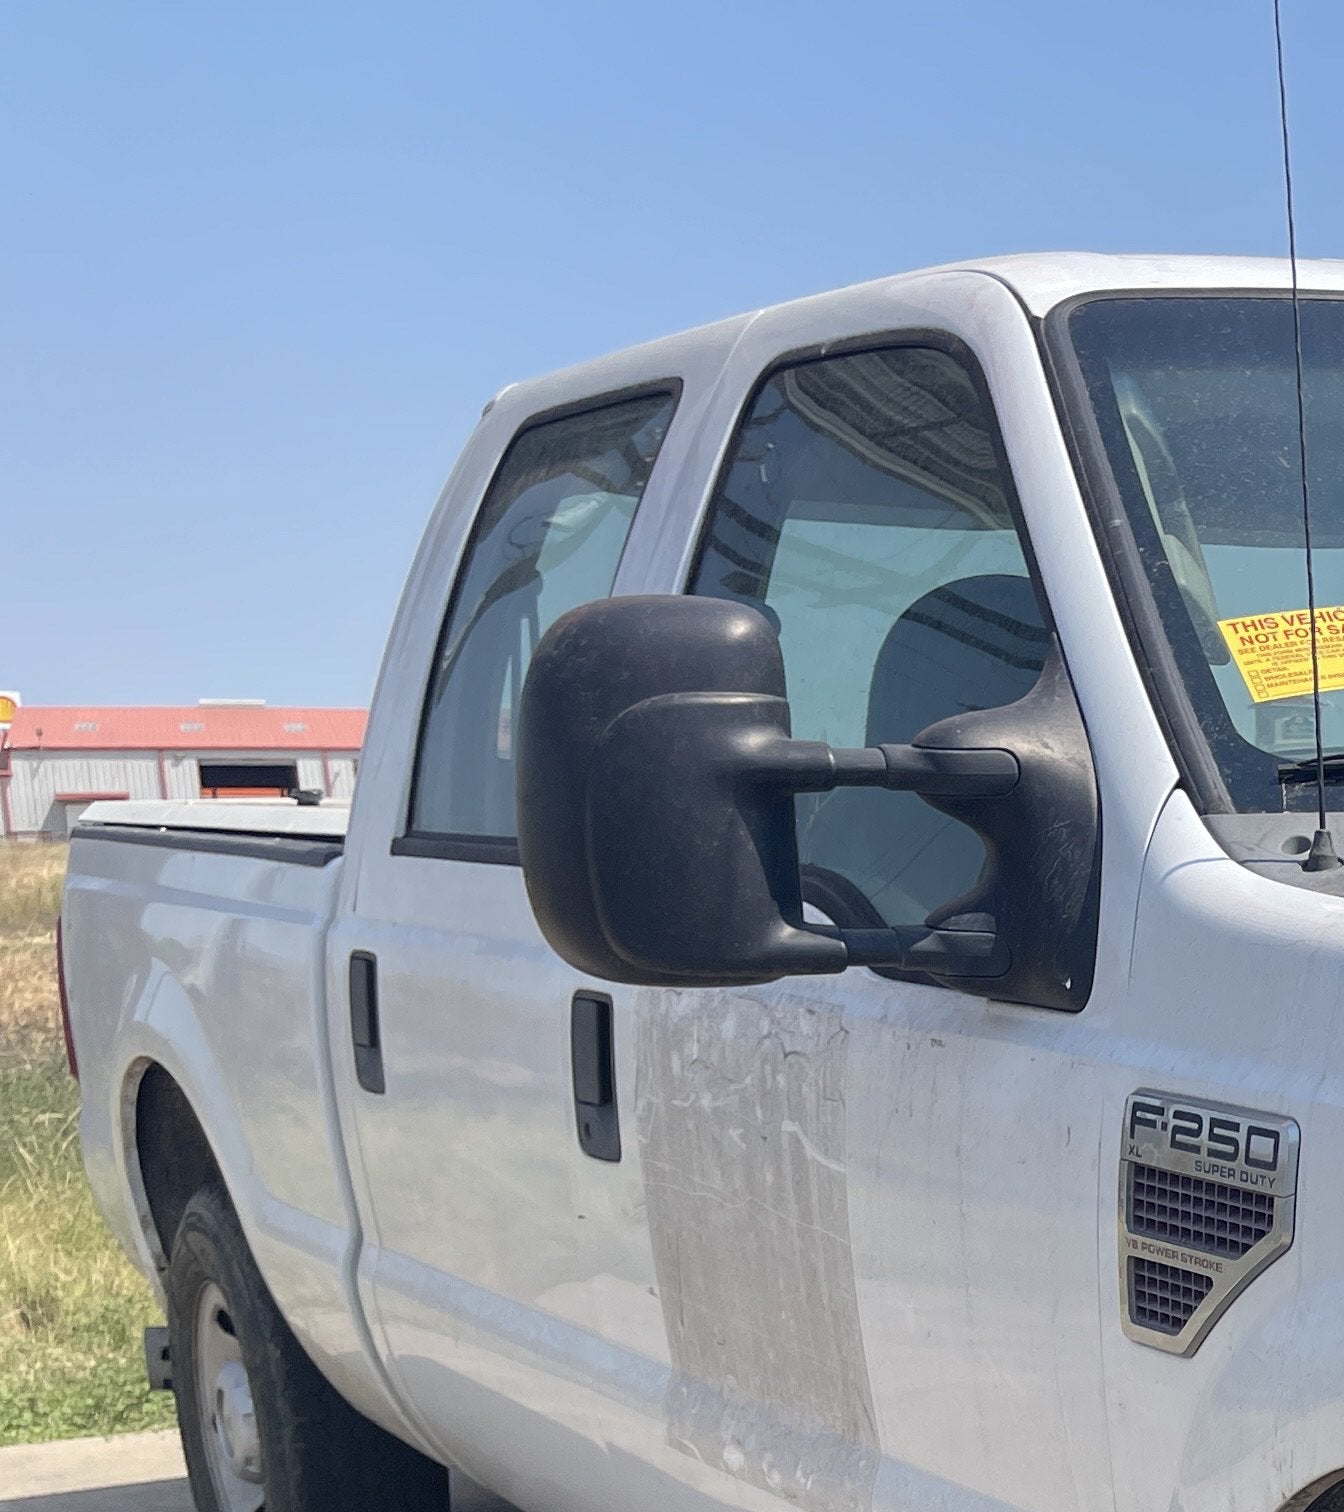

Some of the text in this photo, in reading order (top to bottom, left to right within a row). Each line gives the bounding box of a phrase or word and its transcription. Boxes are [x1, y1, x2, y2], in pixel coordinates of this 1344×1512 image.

[1226, 617, 1279, 634] THIS
[1239, 631, 1278, 646] NOT
[1284, 626, 1324, 640] FOR
[1238, 647, 1256, 655] SEE
[1258, 641, 1298, 652] DEALER
[1128, 1143, 1143, 1159] XL
[1194, 1160, 1277, 1190] SUPER DUTY
[1140, 1241, 1180, 1261] POWER
[1180, 1252, 1223, 1274] STROKE
